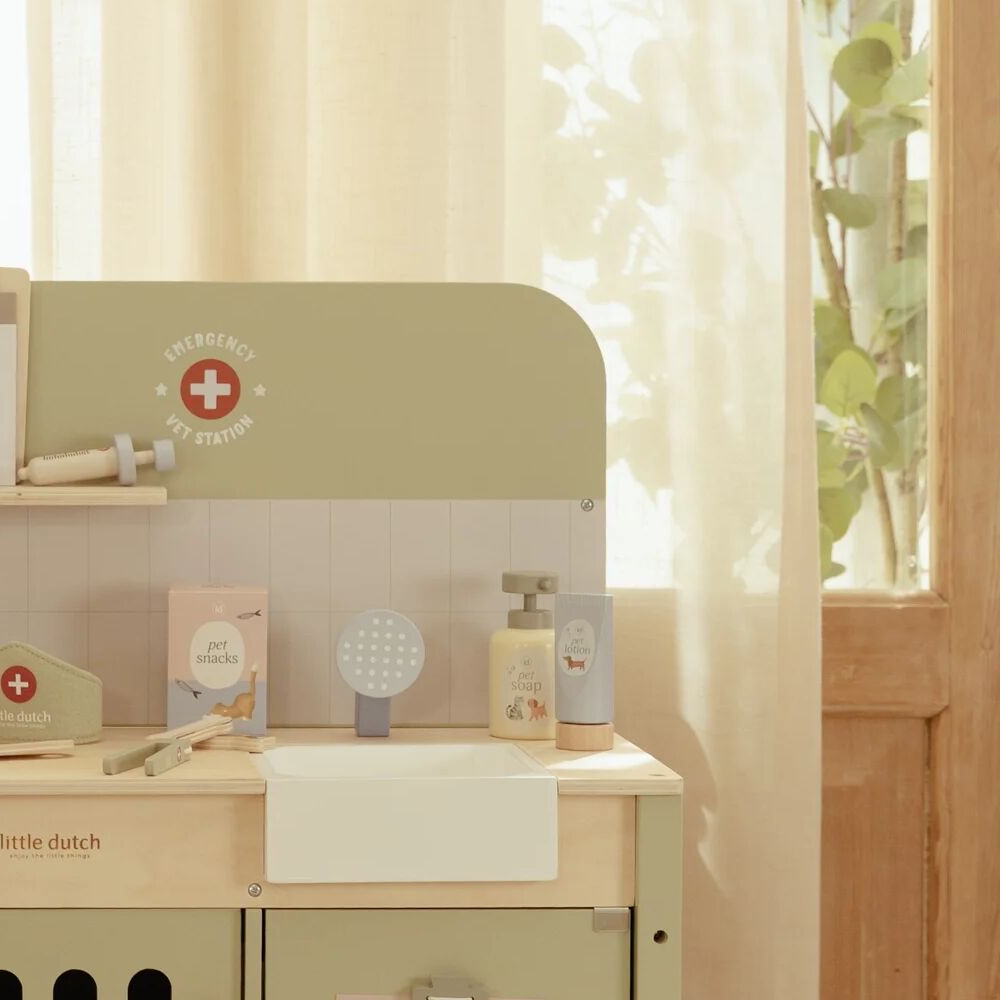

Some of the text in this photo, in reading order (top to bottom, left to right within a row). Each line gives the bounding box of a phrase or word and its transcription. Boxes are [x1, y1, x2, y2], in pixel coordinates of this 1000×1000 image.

[163, 332, 257, 362] EMERGENCY
[166, 413, 254, 446] VET STATION
[207, 640, 229, 653] pet
[564, 644, 591, 655] lotion
[196, 651, 239, 664] snacks
[517, 671, 535, 682] pet
[511, 681, 542, 695] soap
[17, 710, 51, 723] dutch
[0, 833, 100, 850] little dutch
